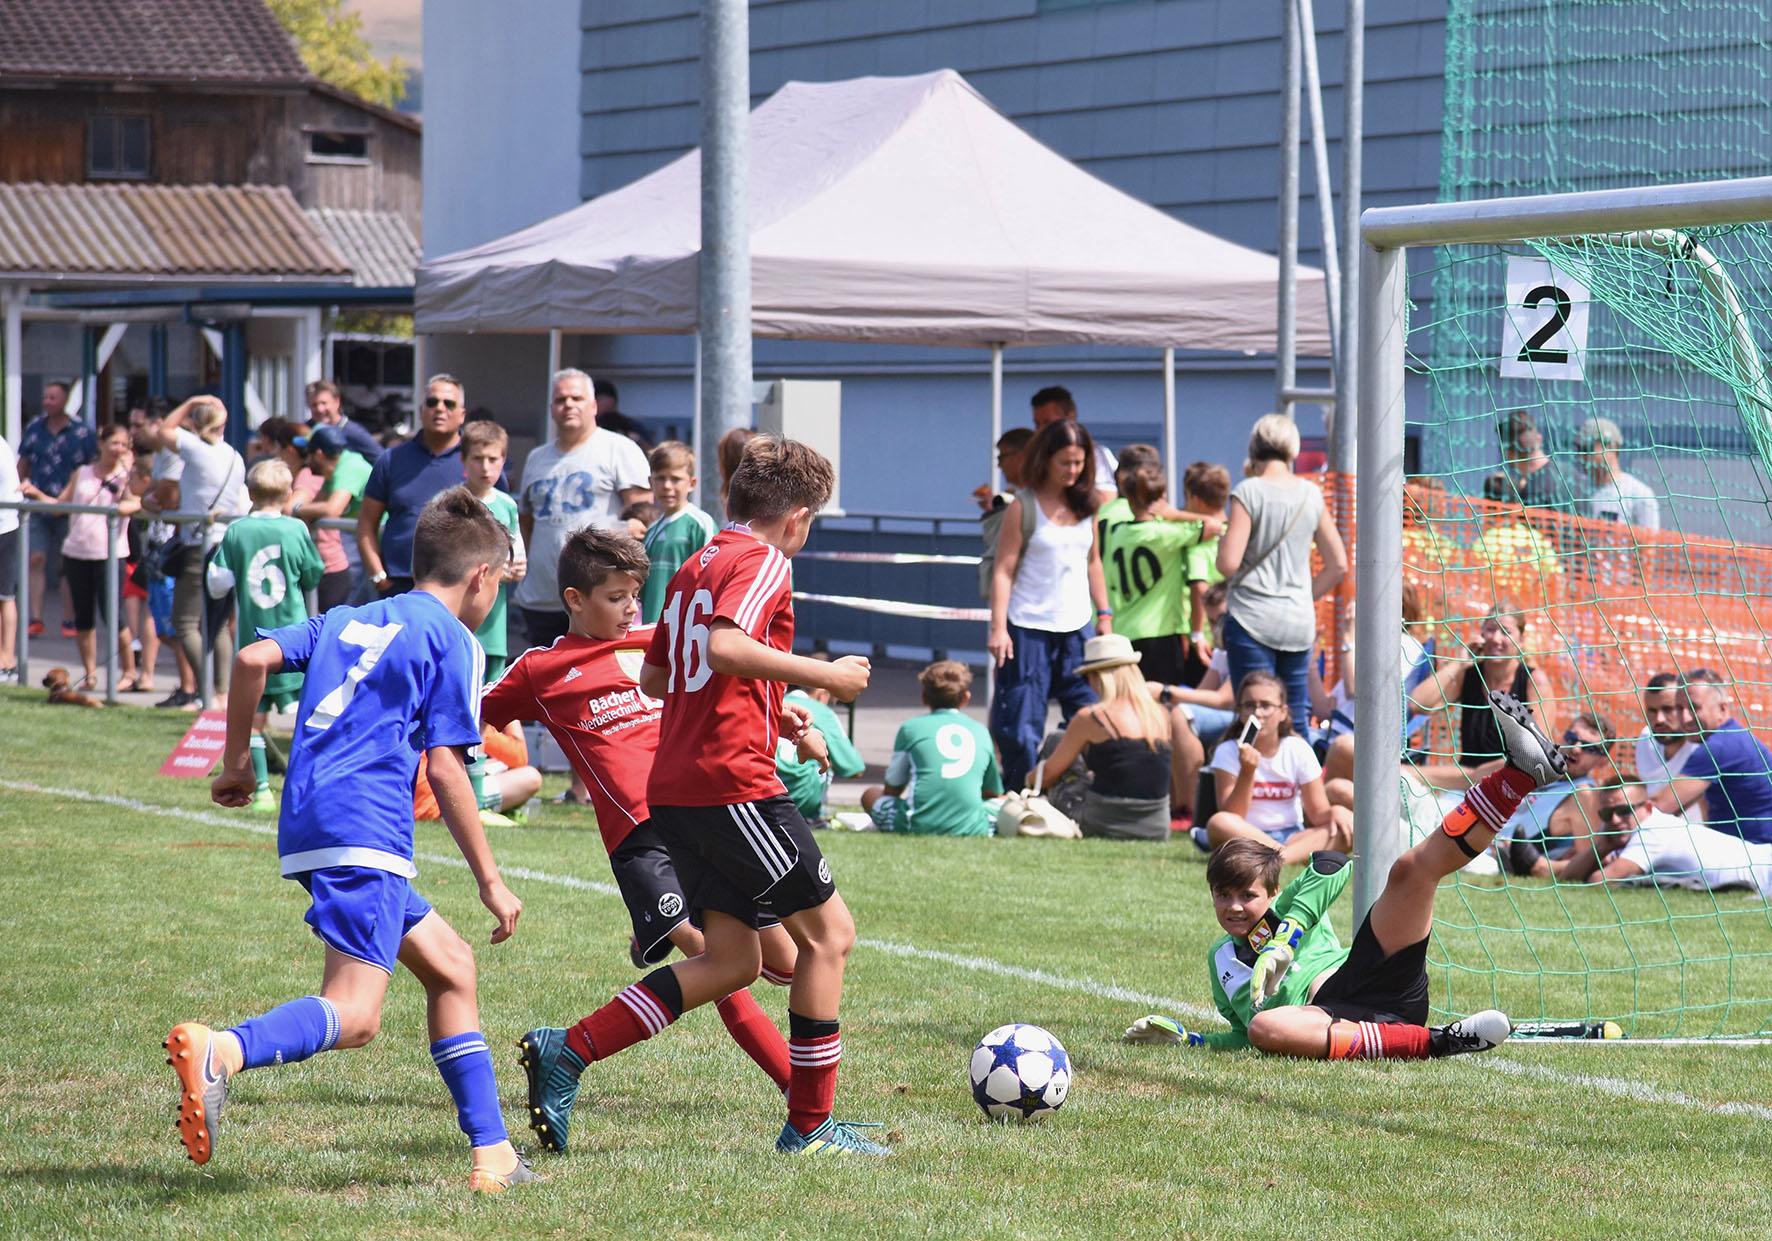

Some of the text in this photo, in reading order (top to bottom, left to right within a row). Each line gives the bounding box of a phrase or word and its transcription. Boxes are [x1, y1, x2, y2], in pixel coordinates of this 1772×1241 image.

[1517, 286, 1571, 364] 2
[529, 471, 594, 517] 73
[247, 544, 286, 609] 6
[1113, 546, 1162, 602] 10
[664, 588, 713, 694] 16
[304, 619, 404, 730] 7
[588, 689, 637, 714] Bächer
[577, 700, 643, 731] Werbetechnik
[936, 723, 976, 779] 9
